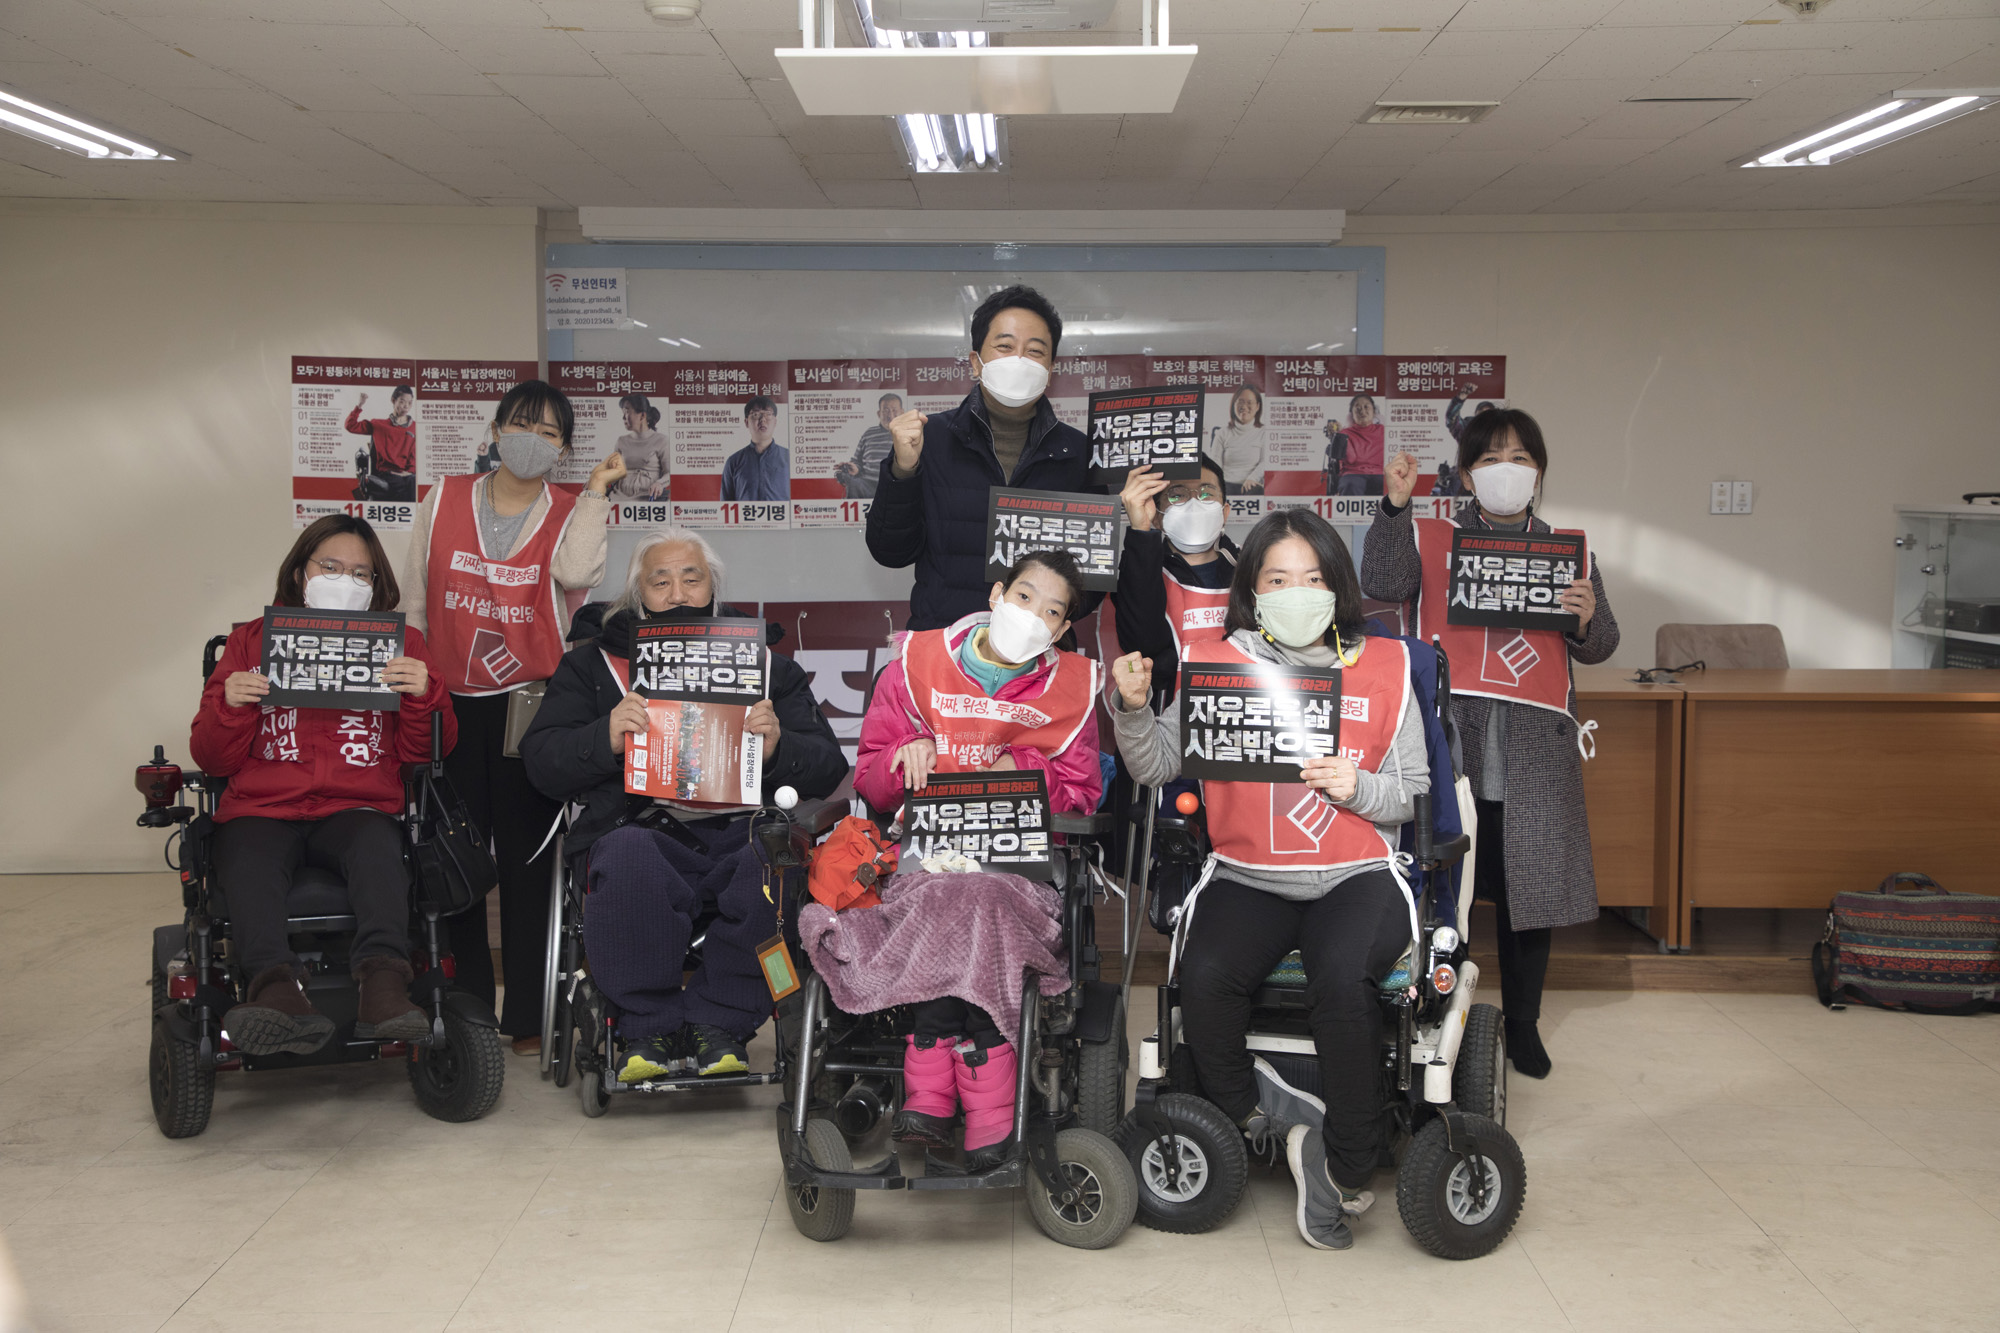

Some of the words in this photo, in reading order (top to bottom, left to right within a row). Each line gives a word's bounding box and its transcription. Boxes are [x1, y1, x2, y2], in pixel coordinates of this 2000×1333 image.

[572, 278, 617, 290] 무선인터넷
[296, 366, 323, 377] 모두가
[326, 366, 361, 378] 평등하게
[364, 367, 390, 379] 이동할
[393, 368, 411, 379] 권리
[562, 366, 607, 379] K-방역을
[610, 366, 634, 380] 넘어,
[1052, 361, 1107, 375] 역사회에서
[1153, 361, 1185, 373] 보호와
[1188, 360, 1220, 373] 통제로
[1222, 360, 1255, 373] 허락된
[1275, 360, 1329, 375] 의사소통,
[1397, 362, 1455, 376] 장애인에게
[1458, 362, 1493, 376] 교육은
[421, 368, 459, 380] 서울시는
[460, 368, 516, 380] 발달장애인이
[674, 370, 705, 382] 서울시
[708, 370, 751, 382] 문화예술,
[794, 368, 844, 383] 탈시설이
[847, 368, 901, 382] 백신이다!
[916, 367, 966, 382] 건강해야
[1167, 375, 1199, 386] 안전을
[1202, 374, 1245, 388] 거부한다
[421, 381, 449, 391] 스스로
[452, 382, 461, 393] 살
[464, 382, 473, 393] 수
[475, 382, 494, 393] 있게
[496, 383, 521, 394] 지원
[597, 380, 657, 394] D-방역으로!
[674, 383, 705, 395] 완전한
[708, 384, 758, 396] 배리어프리
[761, 384, 782, 395] 실현
[1082, 376, 1107, 390] 함께
[1109, 375, 1133, 389] 살자
[1282, 377, 1320, 392] 선택이
[1323, 378, 1348, 391] 아닌
[1352, 377, 1378, 392] 권리
[1397, 377, 1458, 391] 생명입니다.
[1153, 394, 1199, 406] 제정하라!
[298, 411, 308, 420] 01
[794, 416, 804, 424] 01
[298, 426, 309, 435] 02
[794, 426, 804, 434] 02
[1093, 410, 1174, 441] 자유로운
[1175, 409, 1198, 434] 삶
[675, 431, 685, 440] 01
[795, 436, 805, 444] 03
[298, 441, 309, 450] 03
[675, 443, 686, 452] 02
[1270, 443, 1280, 451] 02
[298, 456, 309, 464] 04
[676, 456, 686, 464] 03
[1088, 437, 1199, 469] 시설밖으로
[1270, 455, 1280, 463] 03
[557, 470, 568, 479] 05
[796, 466, 806, 474] 06
[344, 503, 364, 519] 11
[367, 506, 413, 522] 최영은
[606, 503, 620, 525] 1
[623, 505, 666, 522] 이희영
[721, 504, 739, 525] 11
[742, 505, 785, 522] 한기명
[840, 502, 859, 522] 11
[1065, 502, 1114, 515] 제정하라!
[1227, 499, 1260, 516] 주연
[1314, 498, 1333, 519] 11
[1336, 499, 1379, 516] 이미정
[1432, 499, 1451, 519] 11
[994, 514, 1088, 544] 자유로운
[1089, 521, 1114, 545] 삶
[1530, 542, 1577, 555] 제정하라!
[456, 555, 481, 572] 가짜,
[493, 567, 538, 583] 투쟁정당
[1457, 555, 1552, 583] 자유로운
[1553, 560, 1577, 585] 삶
[445, 591, 535, 623] 탈시설장애인당
[346, 621, 398, 633] 제정하라!
[708, 626, 759, 637] 제정하라!
[269, 634, 370, 662] 자유로운
[371, 638, 398, 663] 삶
[637, 641, 734, 664] 자유로운
[735, 641, 760, 666] 삶
[632, 667, 762, 695] 시설밖으로
[1274, 678, 1333, 692] 정하라!
[936, 695, 959, 713] 가짜,
[962, 698, 990, 715] 위성,
[1188, 695, 1301, 727] 자유로운
[1303, 700, 1333, 729] 삶
[664, 711, 676, 735] 2021
[277, 705, 303, 763] 애인
[337, 709, 370, 767] 주연
[746, 737, 756, 788] 탈시설장애인당
[986, 781, 1038, 793] 제정하라!
[911, 801, 1016, 831] 자유로운
[1017, 799, 1044, 828] 삶
